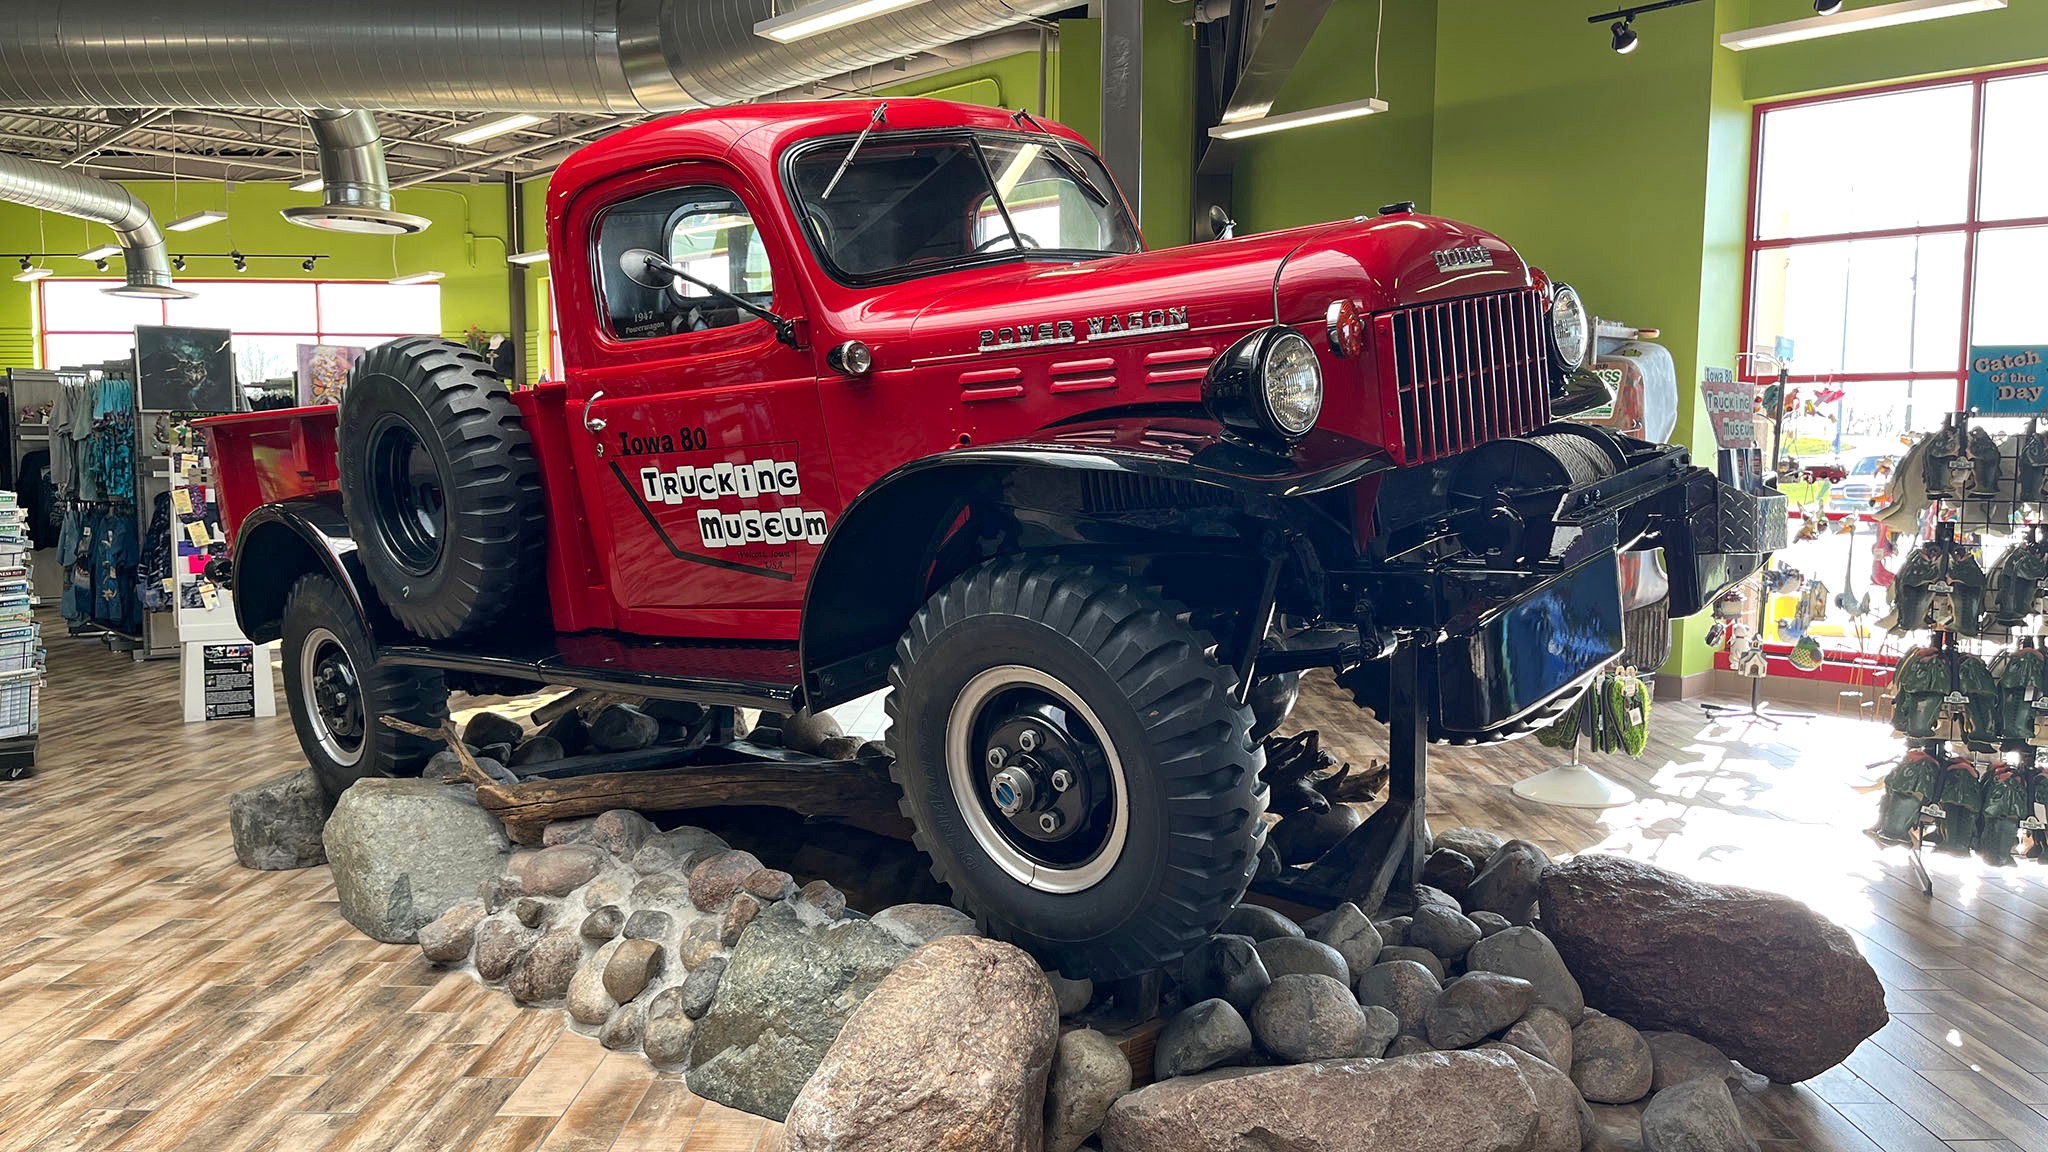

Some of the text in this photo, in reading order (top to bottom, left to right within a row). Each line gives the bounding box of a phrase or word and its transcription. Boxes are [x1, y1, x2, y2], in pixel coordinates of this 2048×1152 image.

[1431, 245, 1491, 267] DODGE
[634, 310, 654, 322] 1947
[978, 305, 1188, 348] POWER WAGON
[1974, 351, 2042, 373] Catch
[1706, 368, 1732, 383] Iowa 80
[1990, 372, 2035, 383] of the
[1997, 385, 2044, 403] Day
[619, 427, 707, 456] Iowa 80
[764, 560, 783, 569] USA
